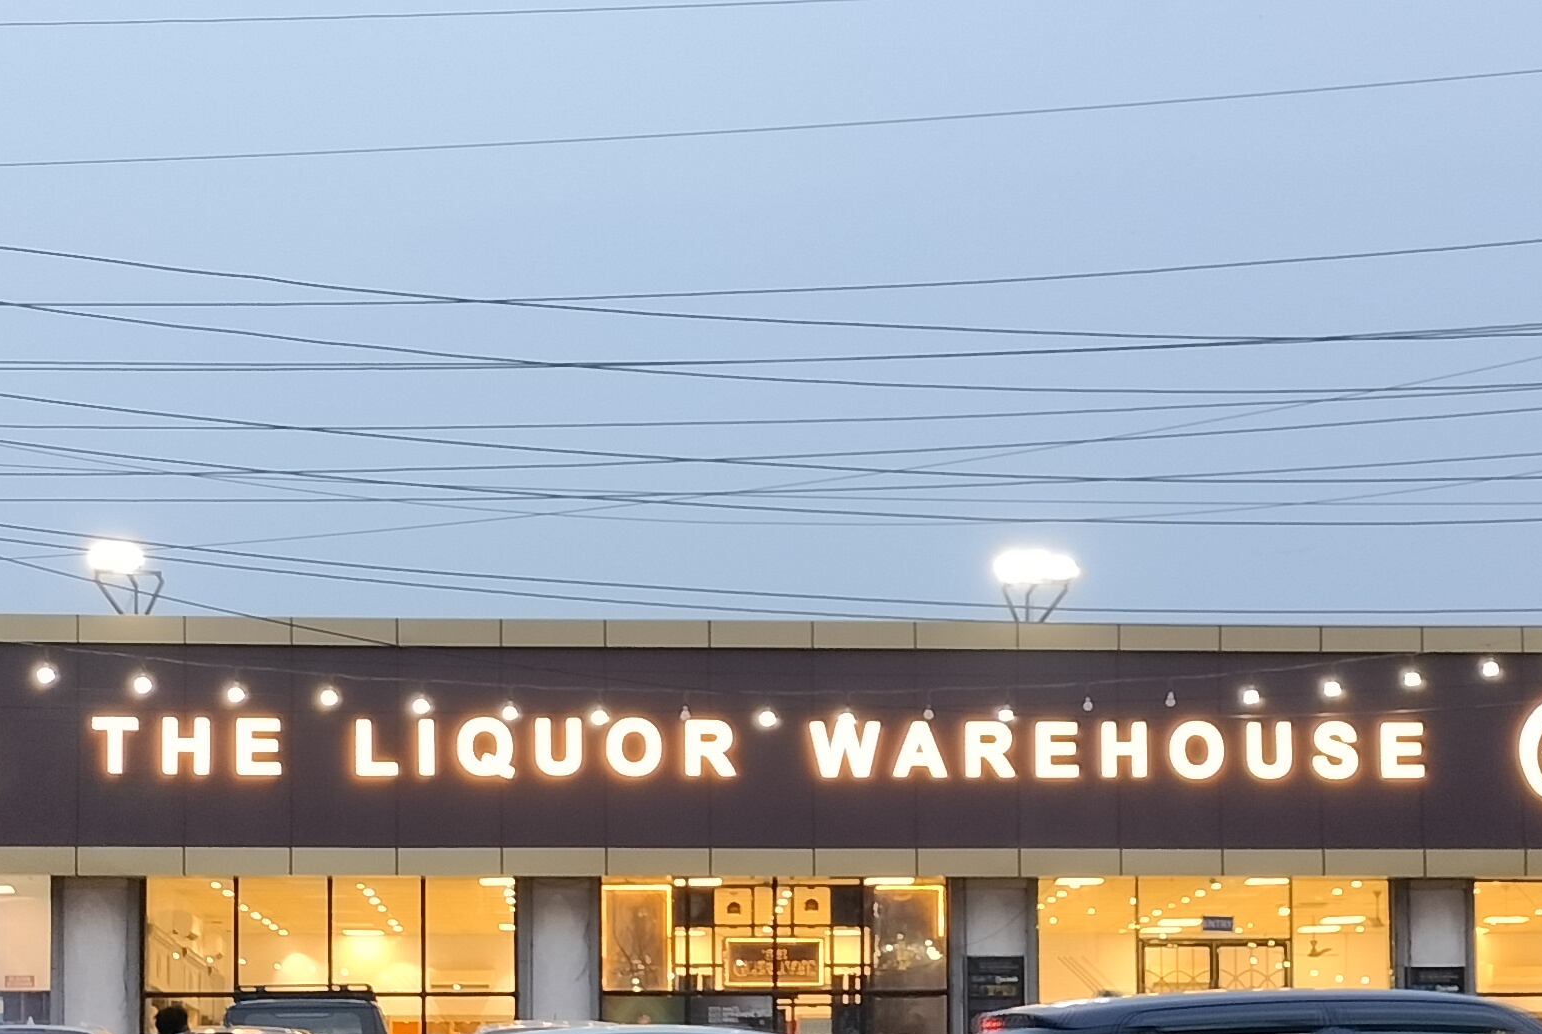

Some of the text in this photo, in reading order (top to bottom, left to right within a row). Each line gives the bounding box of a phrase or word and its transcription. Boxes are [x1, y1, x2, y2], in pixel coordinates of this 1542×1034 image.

[92, 715, 1426, 781] THE LIQUOR WAREHOUSE
